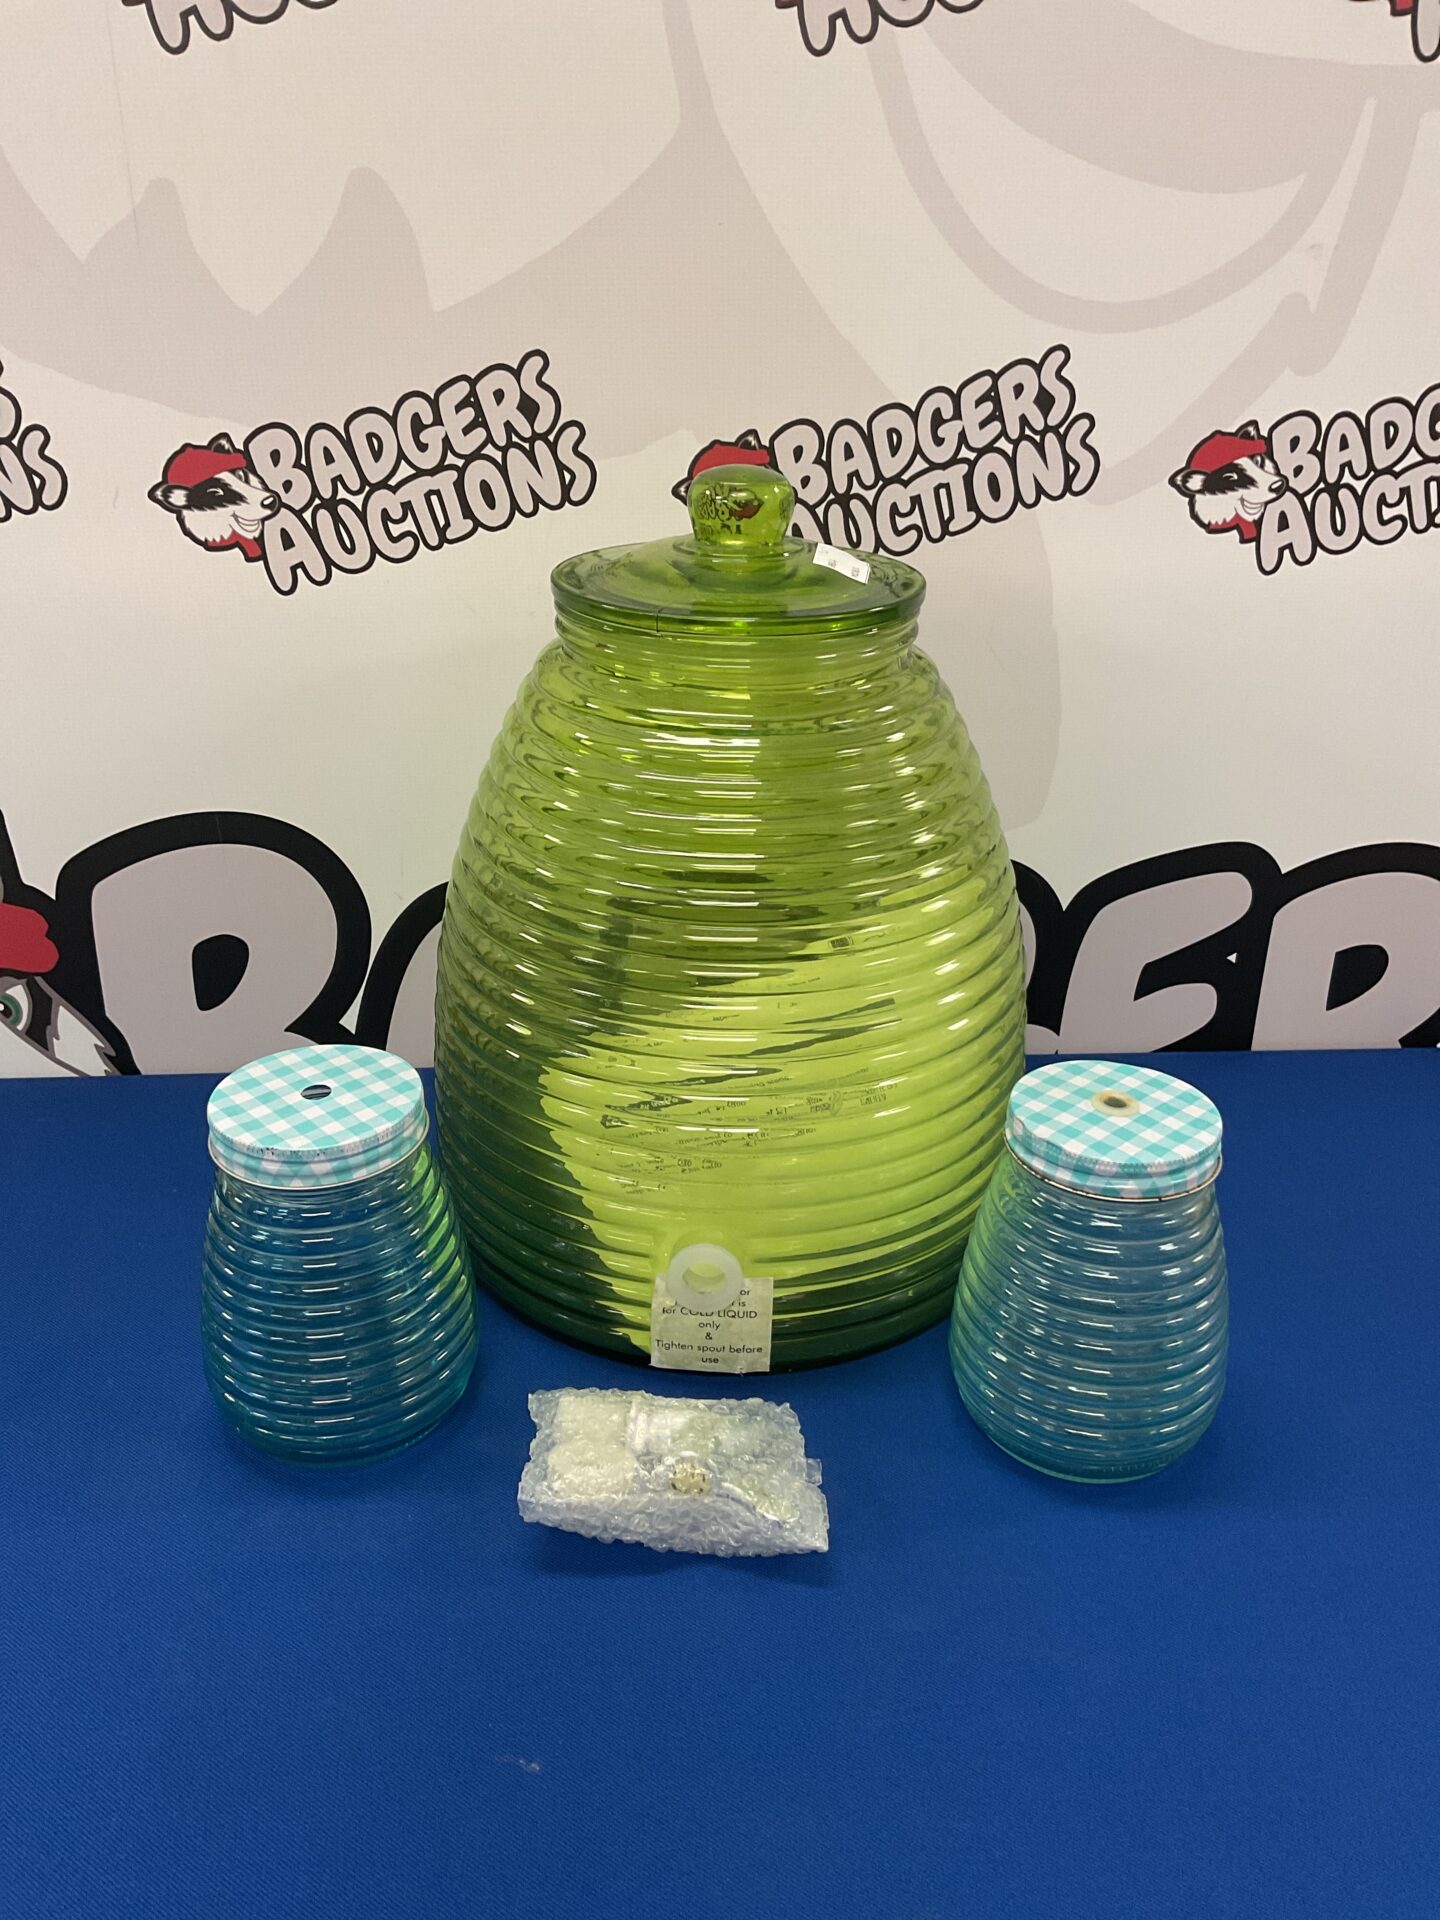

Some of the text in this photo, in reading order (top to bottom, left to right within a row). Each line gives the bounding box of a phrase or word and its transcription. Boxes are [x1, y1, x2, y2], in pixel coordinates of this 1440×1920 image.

[243, 349, 562, 511] BADGERS
[769, 344, 1076, 507] BADGERS
[262, 420, 597, 596] AUCTIONS
[1256, 460, 1440, 575] AUCT
[661, 1306, 676, 1315] for
[717, 1309, 758, 1319] LIQUID
[698, 1320, 721, 1331] only
[704, 1332, 713, 1340] &
[655, 1339, 763, 1354] Tighten spout before
